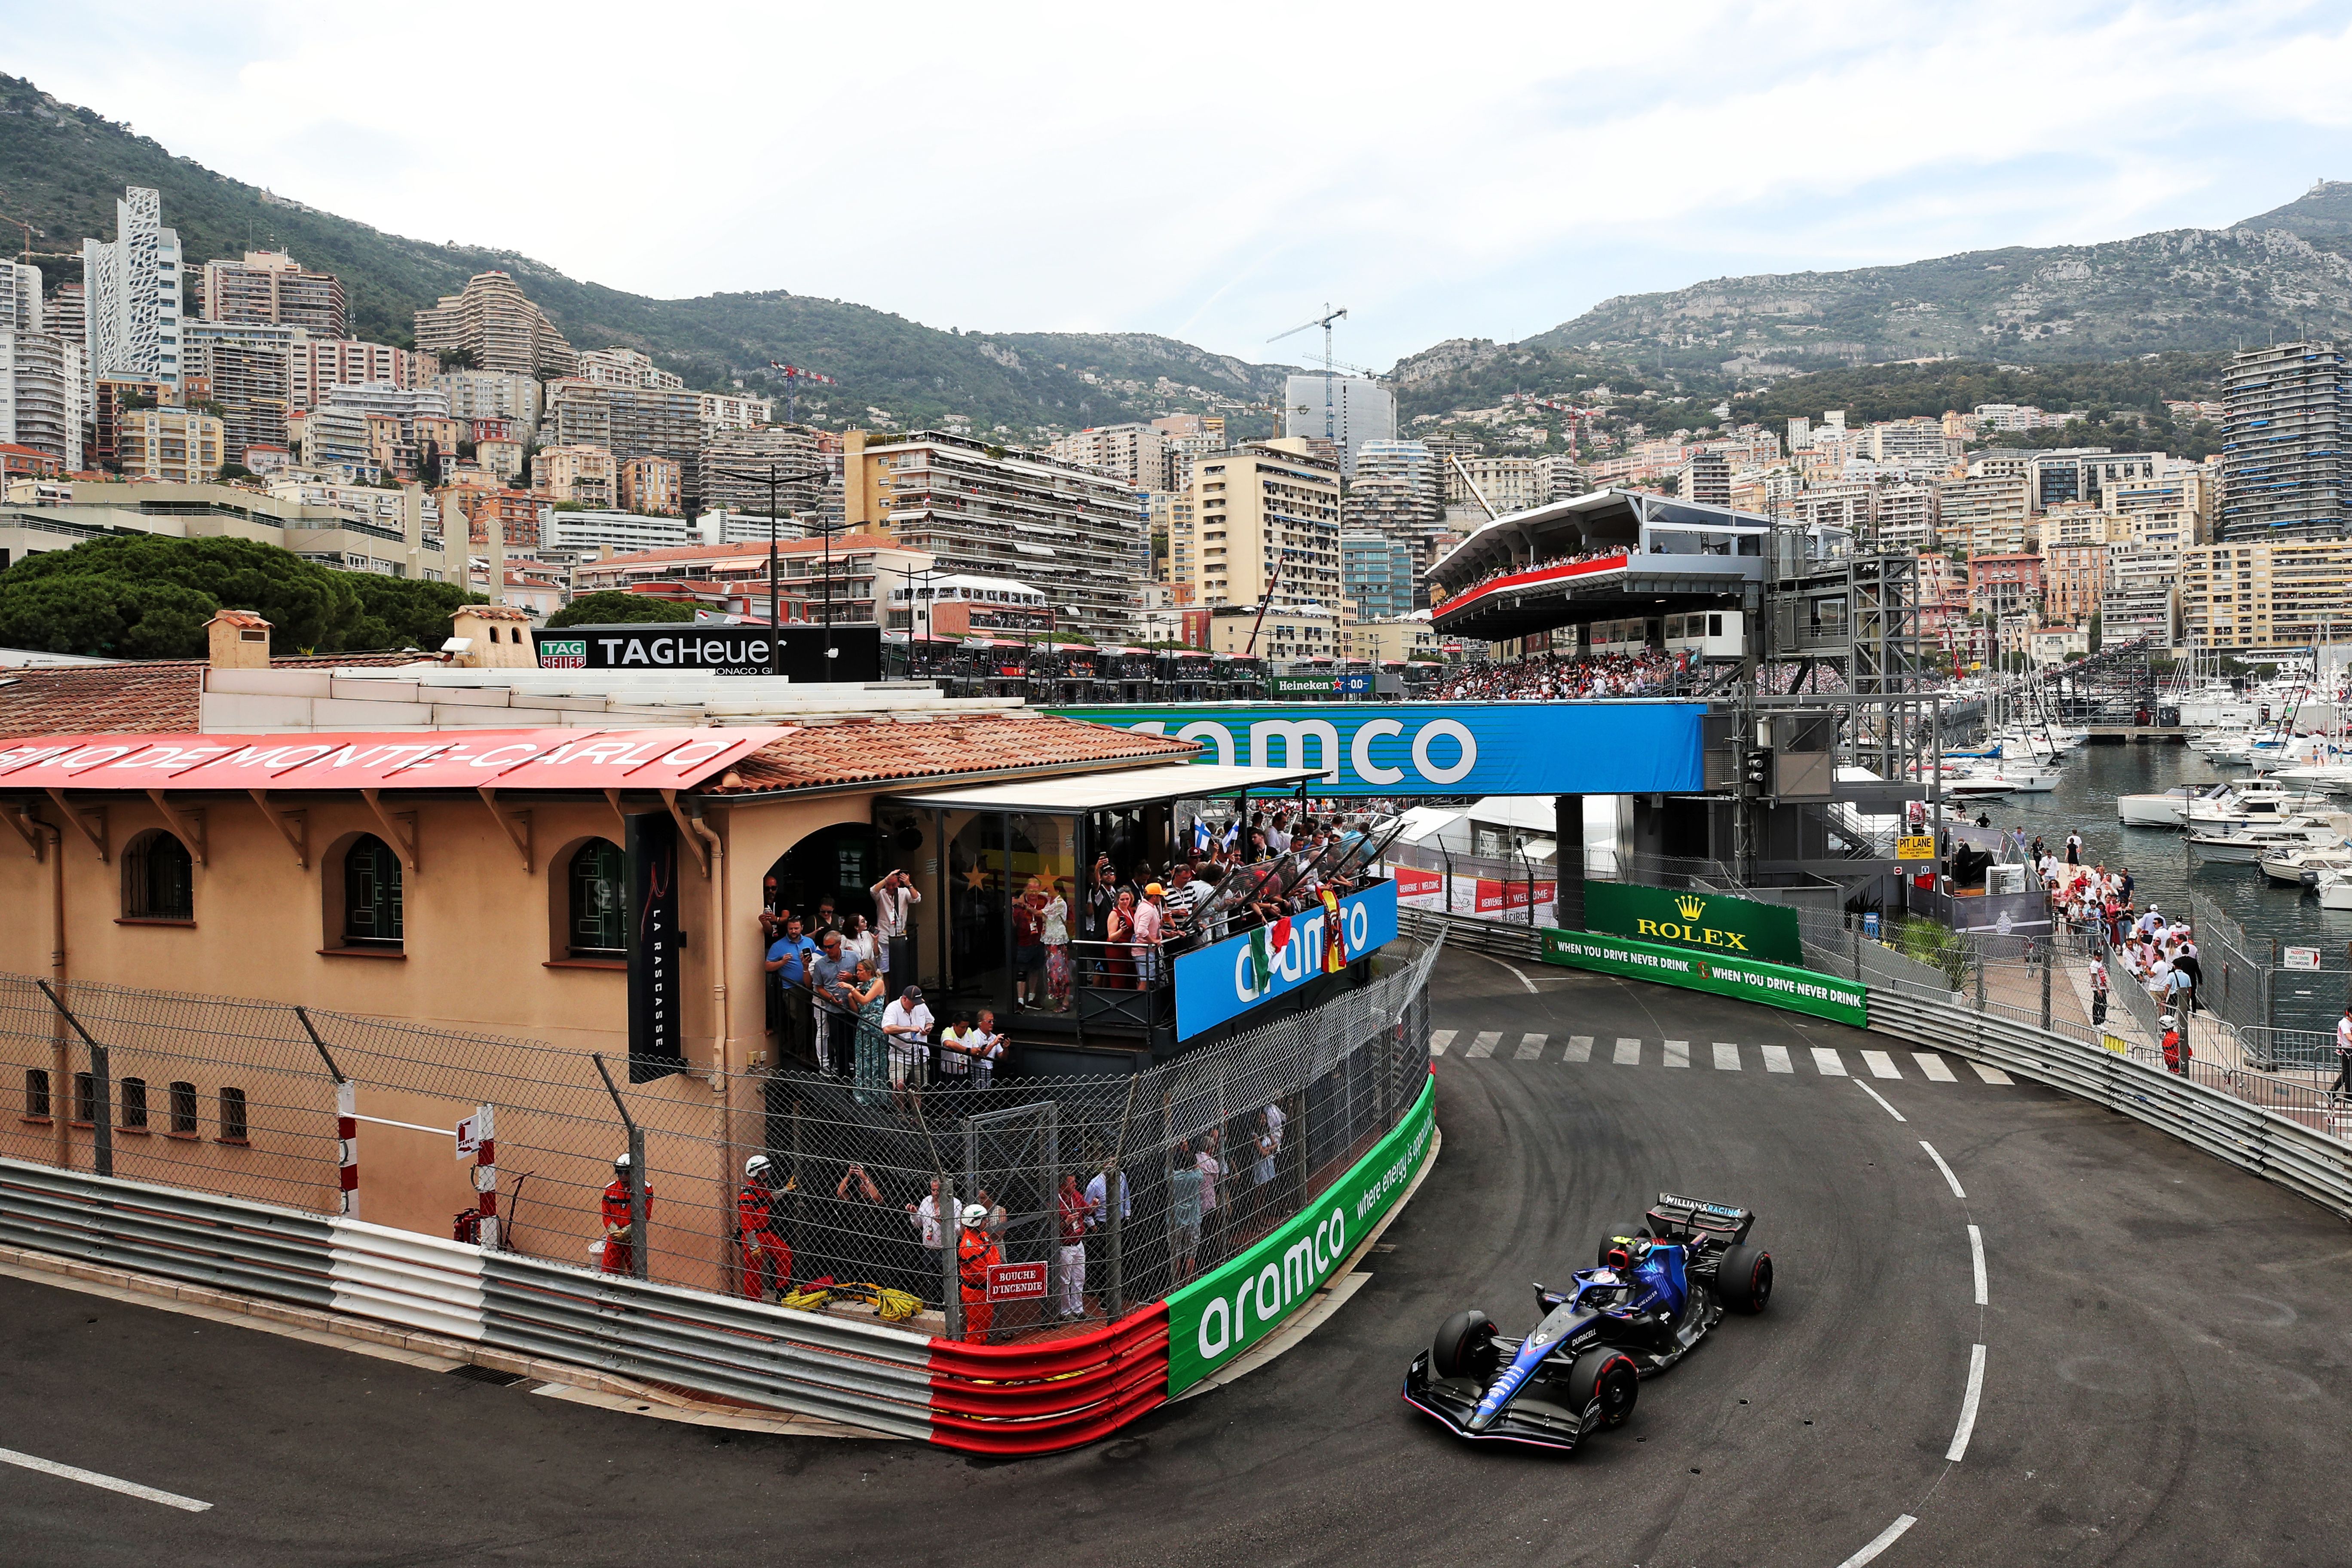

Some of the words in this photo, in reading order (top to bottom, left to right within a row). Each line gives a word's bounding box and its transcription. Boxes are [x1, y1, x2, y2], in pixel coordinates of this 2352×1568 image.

[544, 643, 582, 654] TAG
[714, 667, 757, 675] ONACO
[1279, 681, 1329, 691] Heineken
[107, 747, 231, 768] DE
[202, 741, 734, 768] MONTE-CARLO
[1900, 839, 1910, 848] PIT
[1913, 838, 1931, 847] LANE
[1400, 883, 1418, 893] BIENVENUE
[1422, 880, 1439, 890] WELCOME
[1513, 889, 1547, 903] WELOME
[653, 910, 661, 931] LA
[1637, 919, 1749, 951] ROLEX
[1558, 941, 1581, 954] WHEN
[1583, 946, 1601, 957] YOU
[1604, 949, 1628, 962] DRIVE
[1630, 952, 1658, 967] NEVER
[1660, 959, 1689, 972] DRINK
[654, 942, 663, 1047] RASCASSE
[1712, 967, 1740, 982] WHEN
[1743, 972, 1764, 986] YOU
[1767, 977, 1795, 993] DRIVE
[1797, 983, 1828, 1000] NEVER
[1830, 989, 1862, 1008] DRINK
[458, 1137, 475, 1147] FIRE
[1666, 1194, 1709, 1212] WILLIAMS
[1708, 1205, 1740, 1217] RACING
[1198, 1207, 1344, 1359] aramco
[1357, 1181, 1380, 1221] where
[1383, 1153, 1407, 1193] energy
[1408, 1143, 1412, 1165] is
[999, 1270, 1036, 1282] BOUCHE
[992, 1282, 1042, 1295] D'INCENDIE
[1535, 1334, 1548, 1344] 6
[1572, 1329, 1596, 1347] DURACELL
